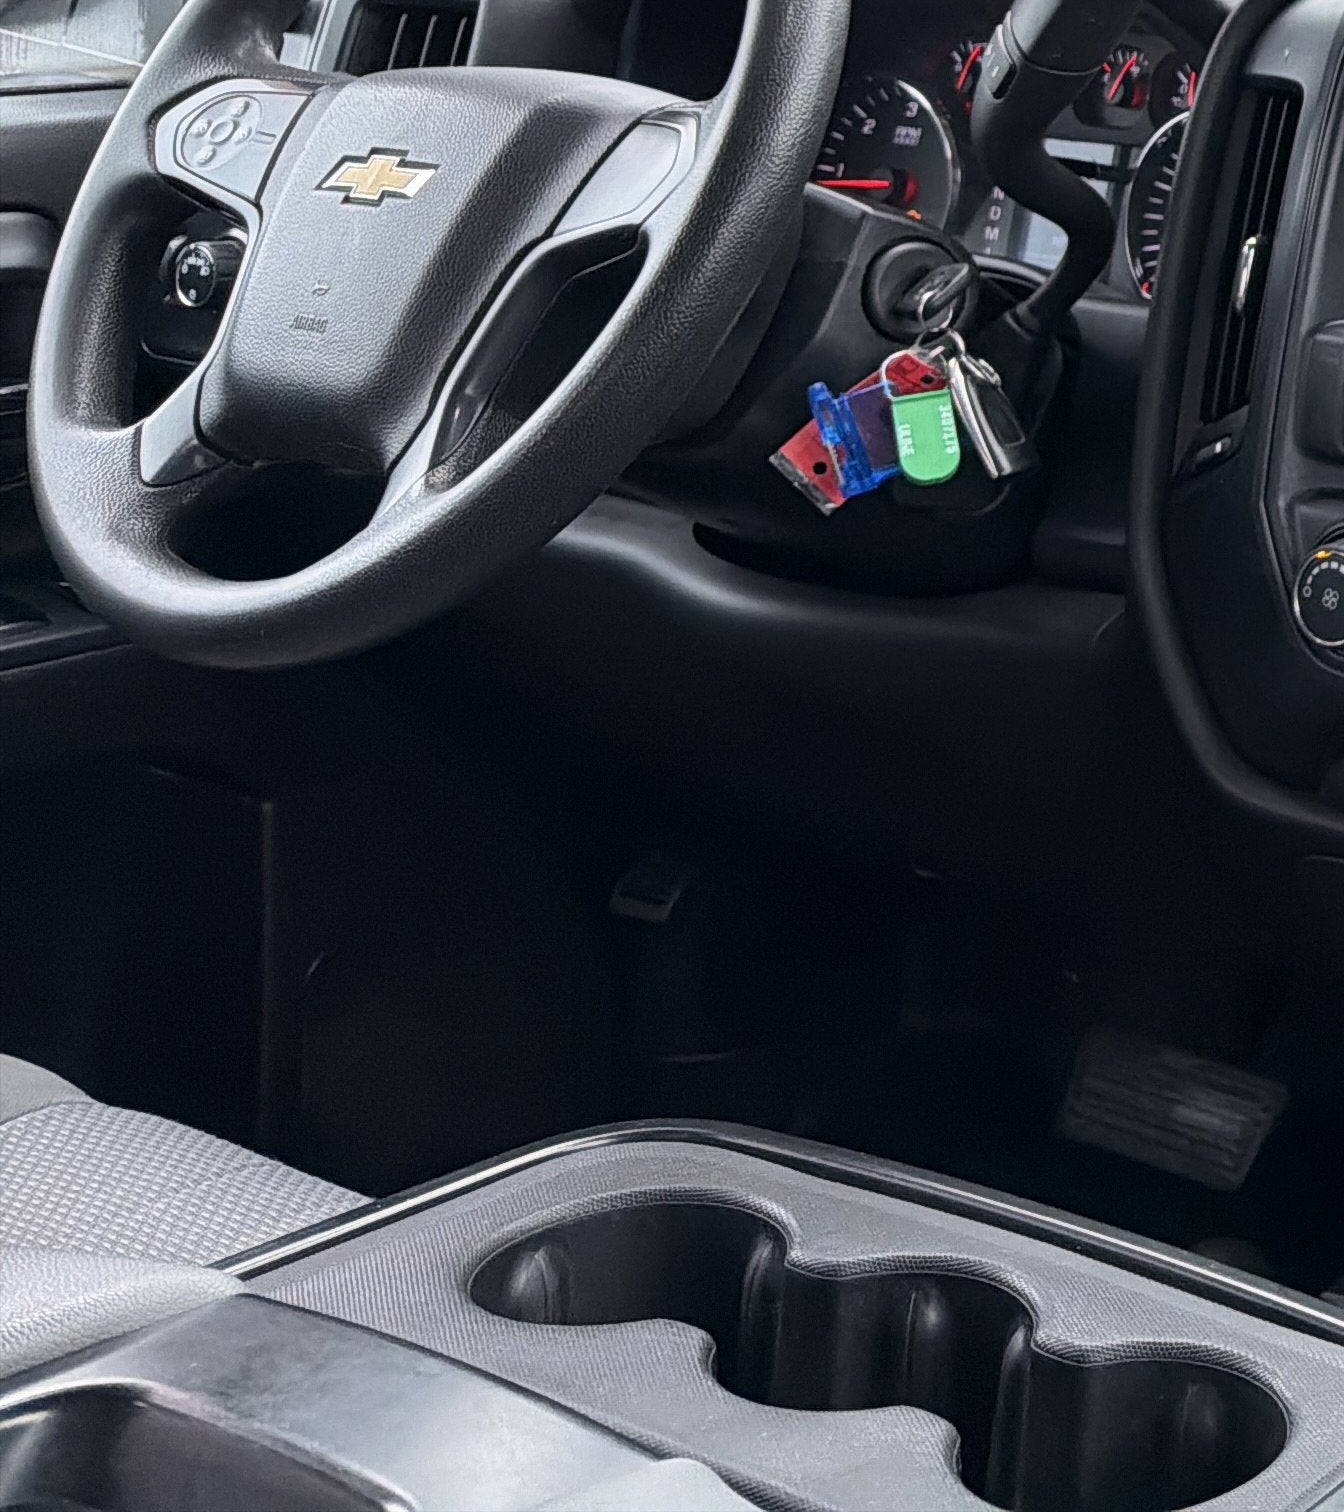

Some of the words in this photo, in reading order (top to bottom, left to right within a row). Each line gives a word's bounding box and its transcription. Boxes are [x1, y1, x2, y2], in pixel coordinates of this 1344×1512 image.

[905, 101, 919, 118] 3
[861, 118, 877, 135] 2
[990, 205, 1002, 221] D
[985, 226, 1000, 240] M
